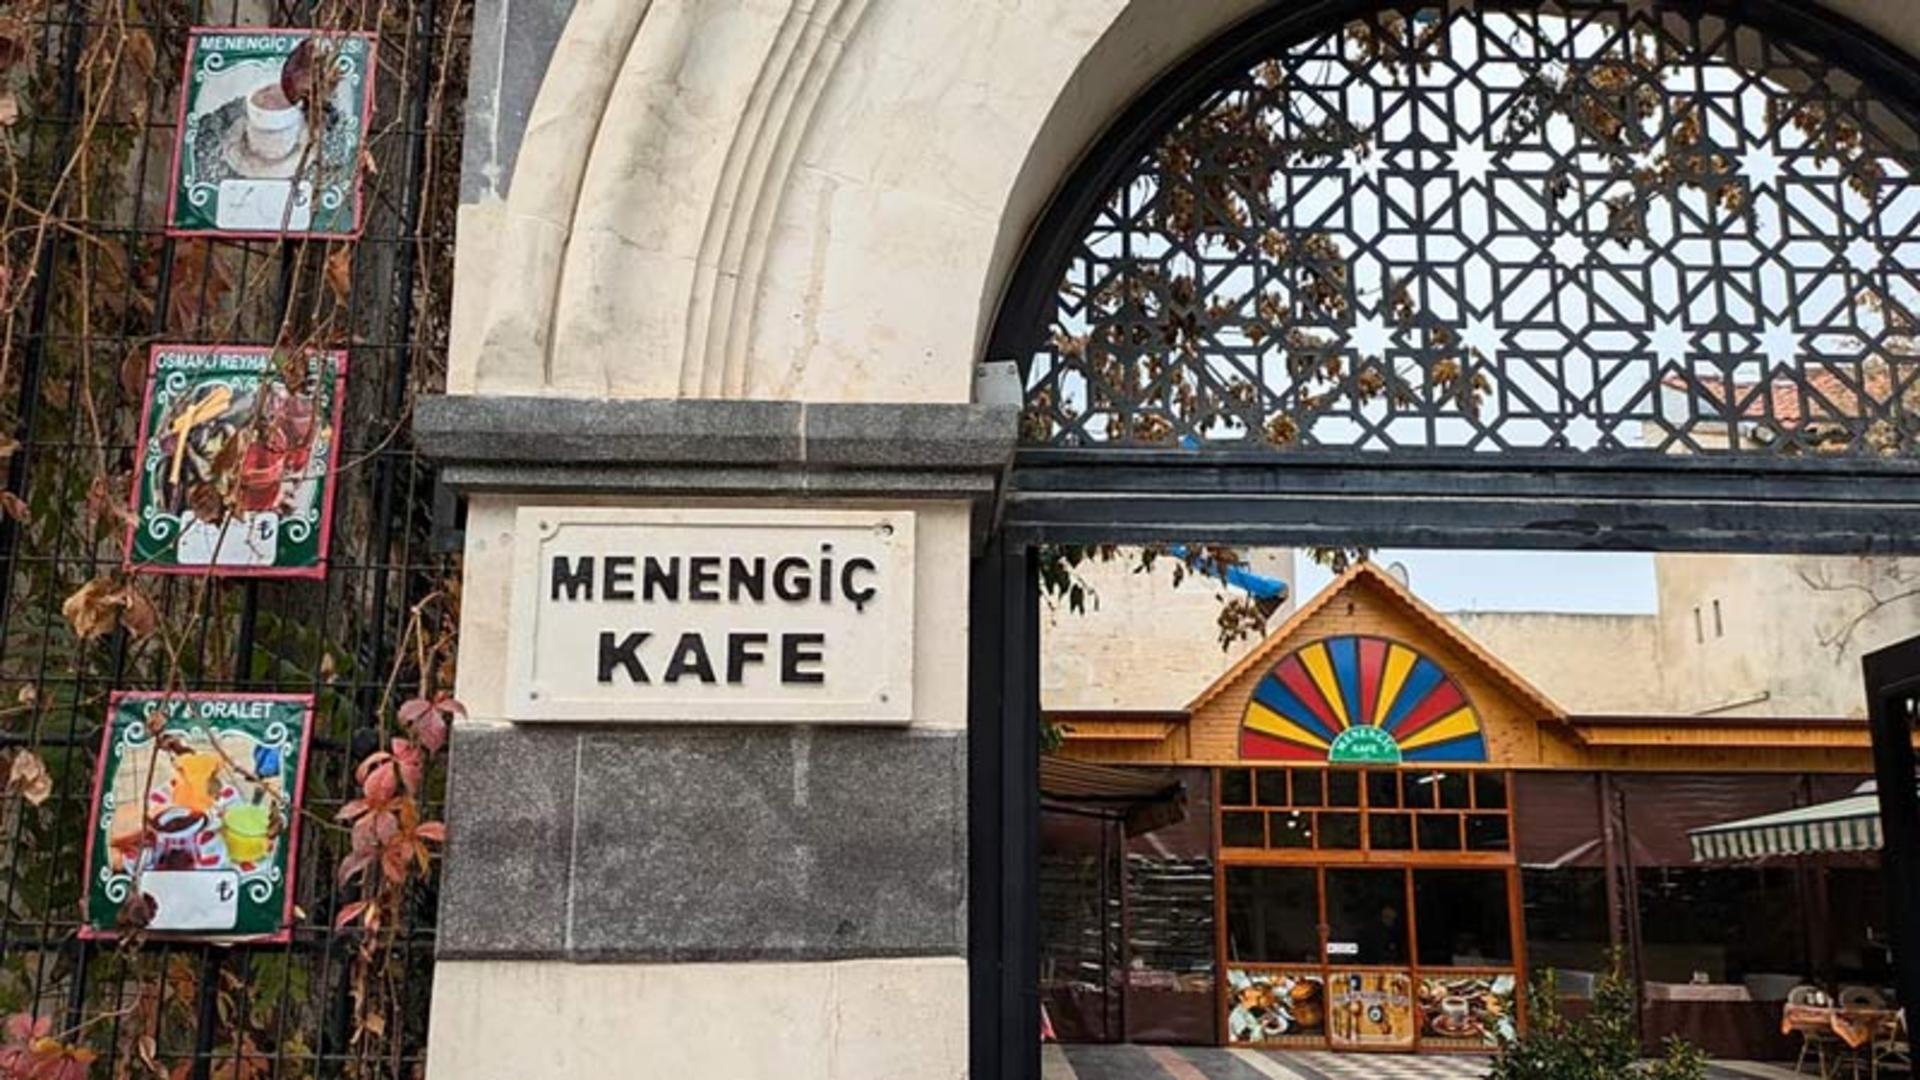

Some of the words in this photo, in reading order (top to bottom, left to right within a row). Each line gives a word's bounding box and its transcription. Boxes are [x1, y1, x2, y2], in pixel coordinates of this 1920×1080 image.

[219, 353, 277, 370] REYHA
[551, 543, 877, 613] MENENGİÇ
[597, 631, 827, 685] KAFE
[201, 702, 274, 719] ORALET
